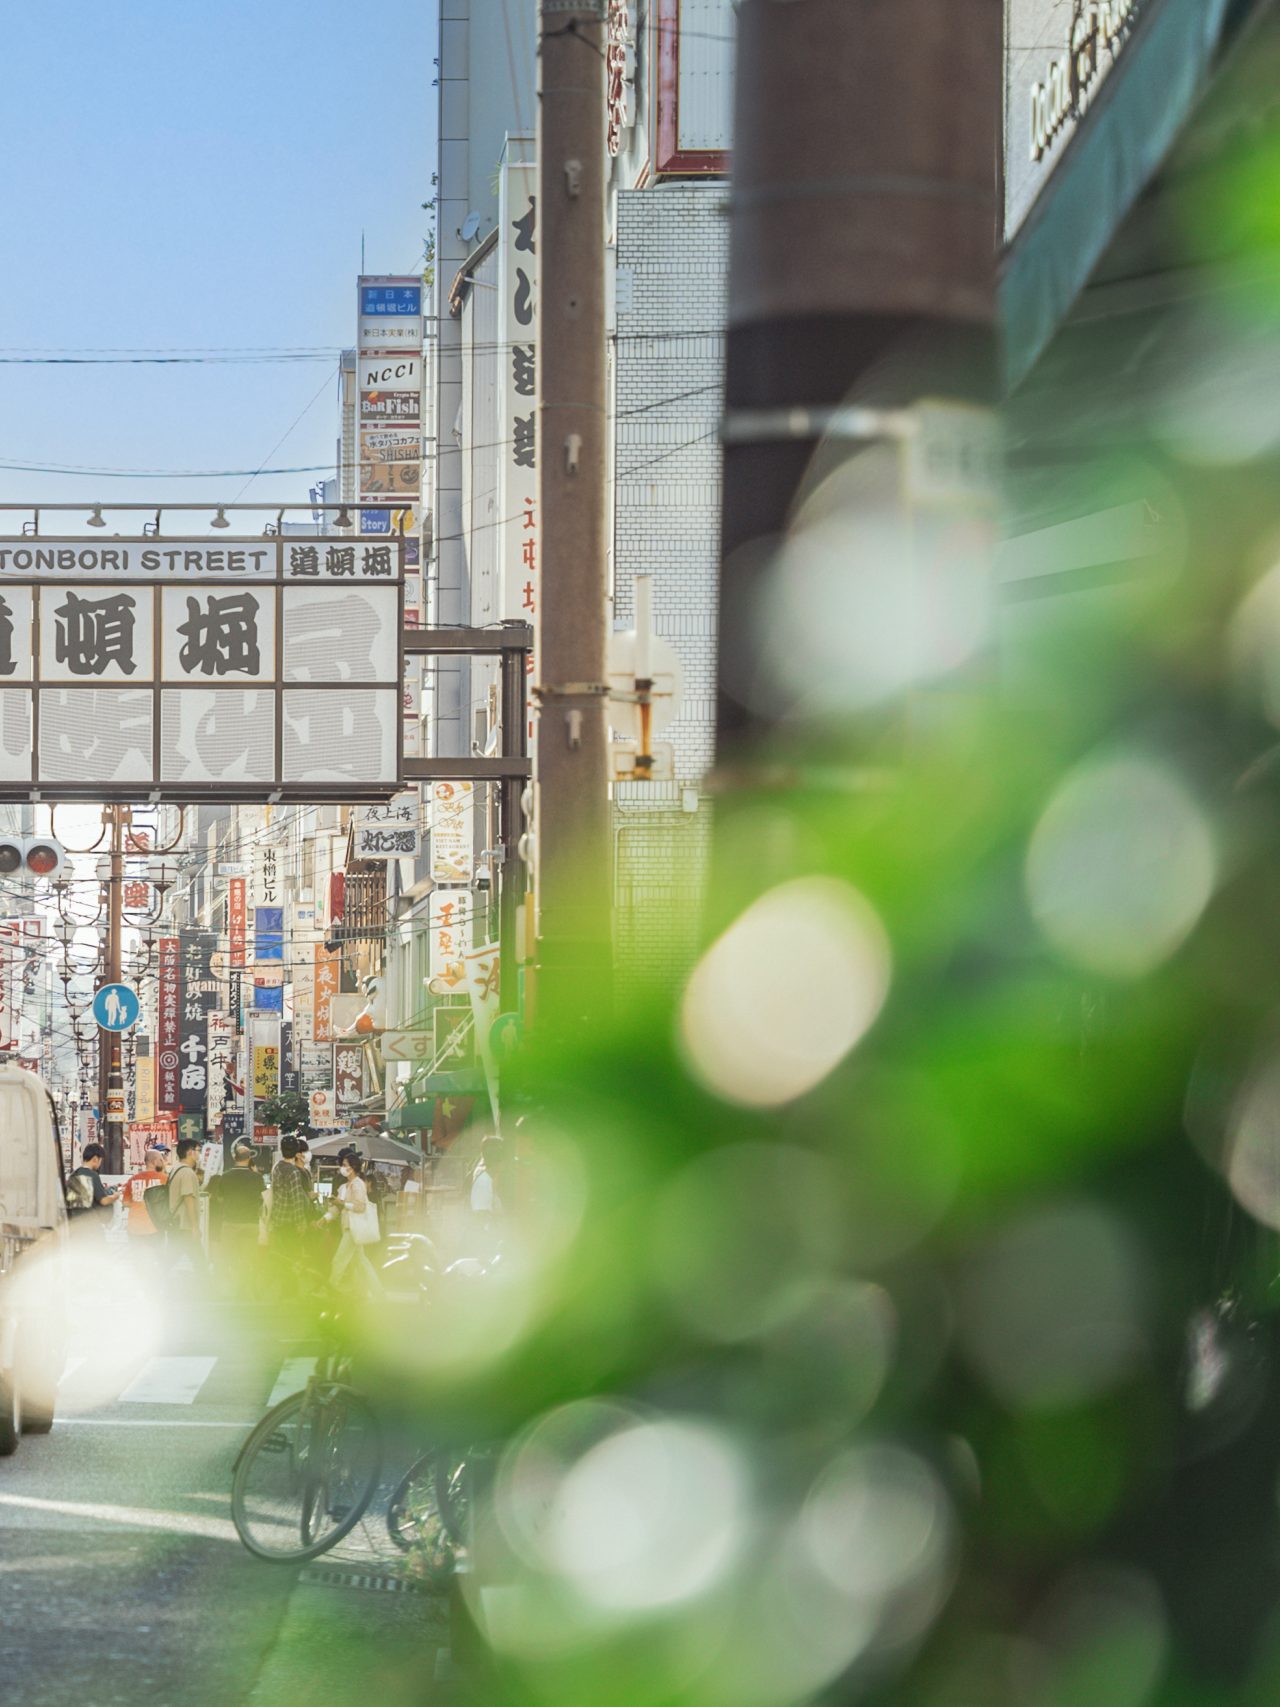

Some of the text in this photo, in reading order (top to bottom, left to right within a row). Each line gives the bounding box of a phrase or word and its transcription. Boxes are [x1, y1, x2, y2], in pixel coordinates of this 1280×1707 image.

[367, 362, 413, 385] NCCI
[361, 517, 387, 531] Story
[140, 550, 268, 572] STREET
[290, 546, 392, 576] 道頓堀
[180, 1035, 207, 1090] 千房
[314, 1119, 351, 1128] Tax-Free
